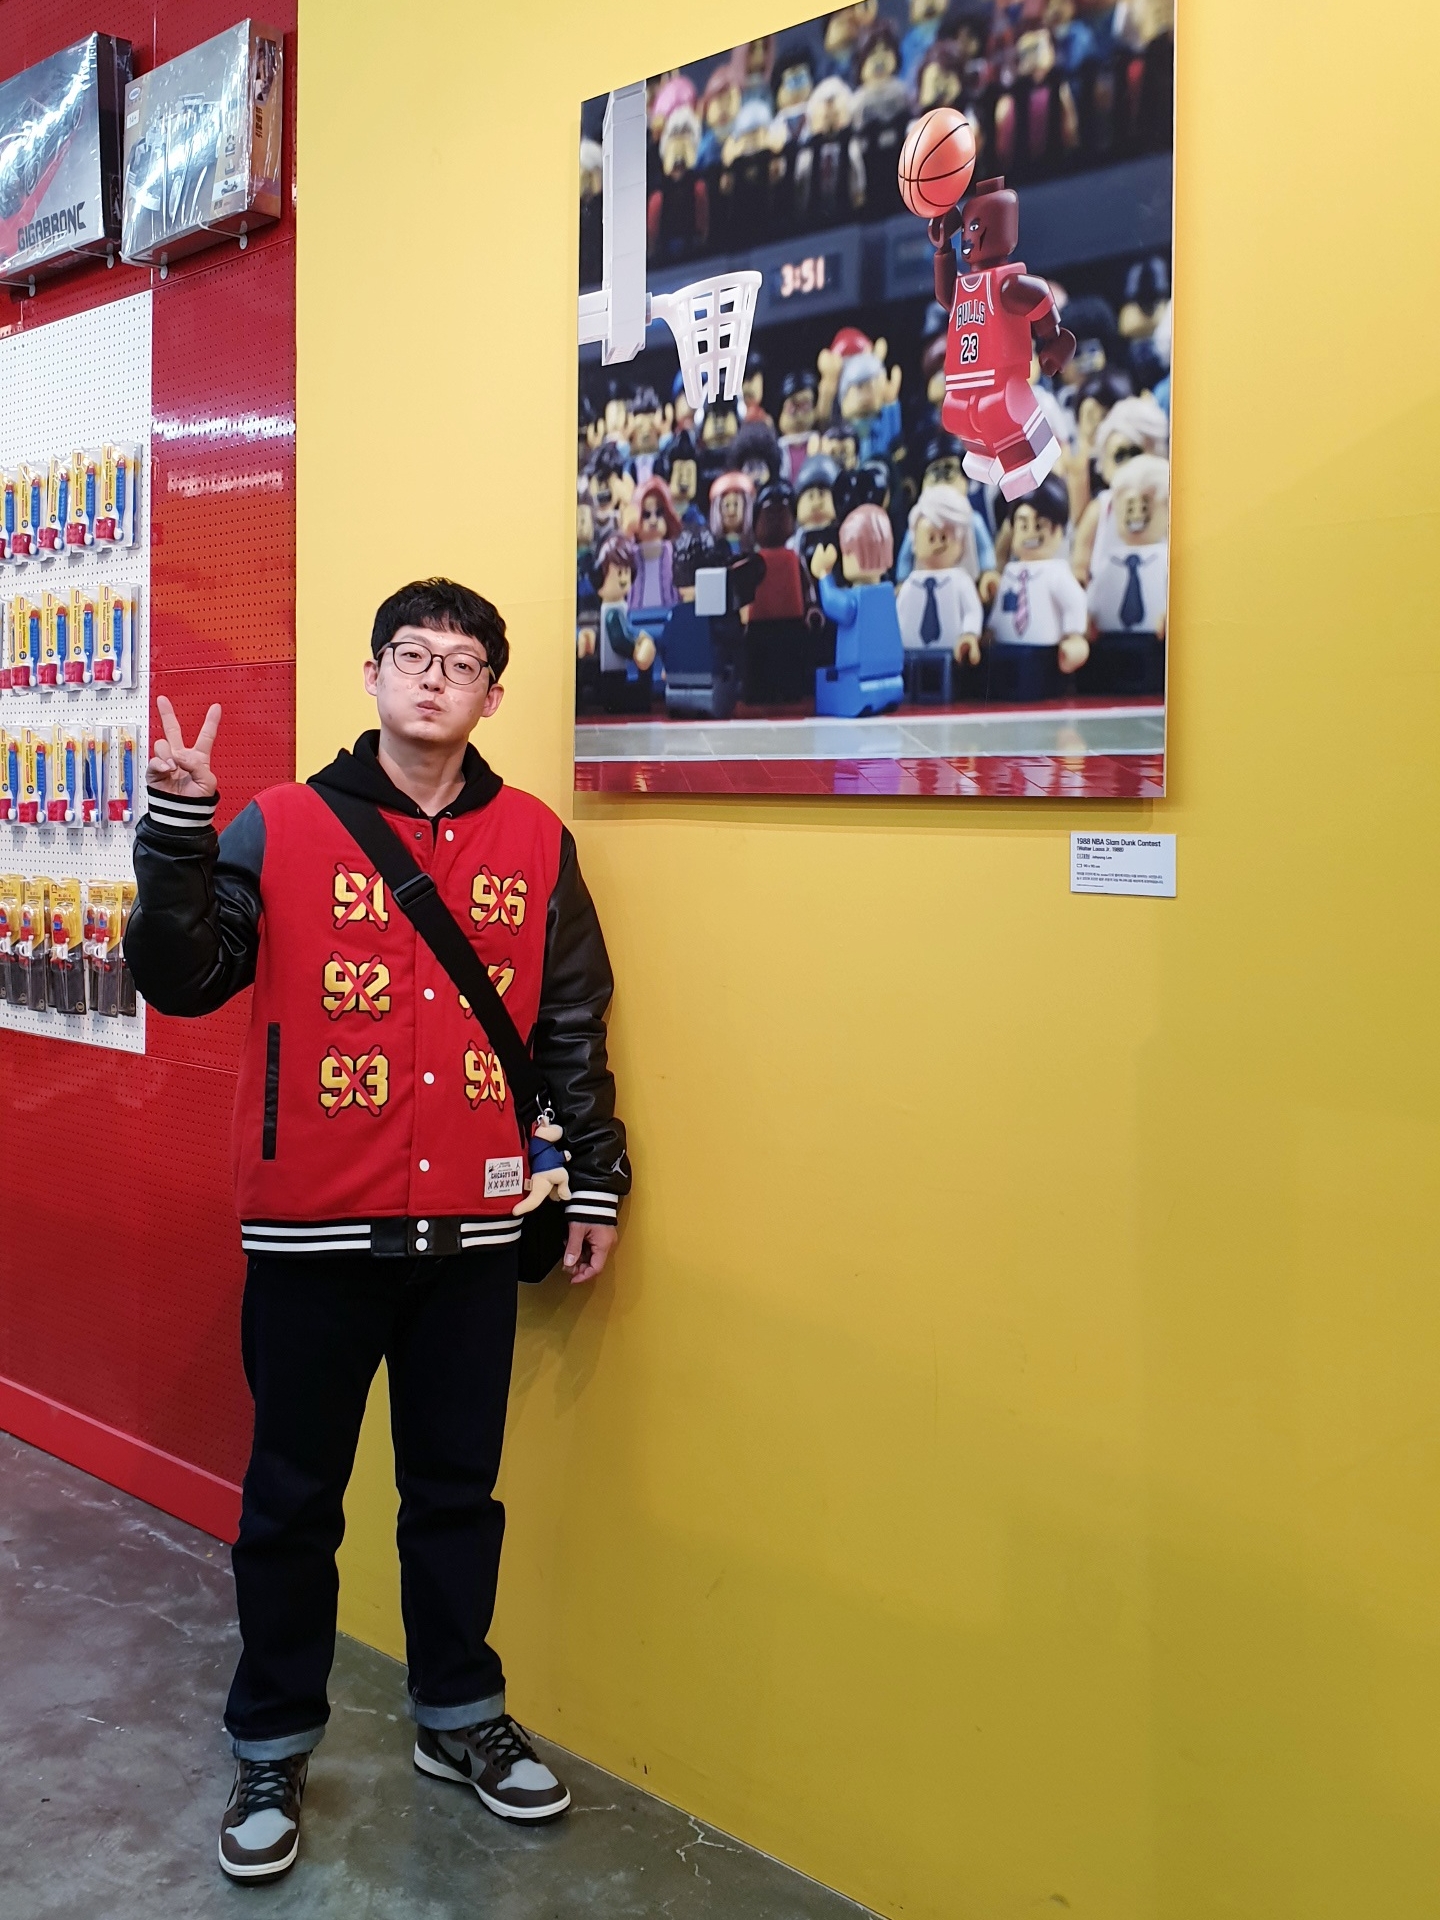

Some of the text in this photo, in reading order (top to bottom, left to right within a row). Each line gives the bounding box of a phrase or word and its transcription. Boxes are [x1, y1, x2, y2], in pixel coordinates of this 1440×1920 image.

[956, 299, 986, 331] BULLS
[960, 333, 978, 364] 23
[1092, 838, 1104, 846] NBA
[1106, 838, 1120, 846] Slam
[1121, 839, 1136, 847] Dunk
[1137, 839, 1161, 847] Contest
[333, 868, 389, 926] 91
[470, 871, 528, 928] 96
[321, 959, 391, 1013] 92
[319, 1053, 389, 1110] 93
